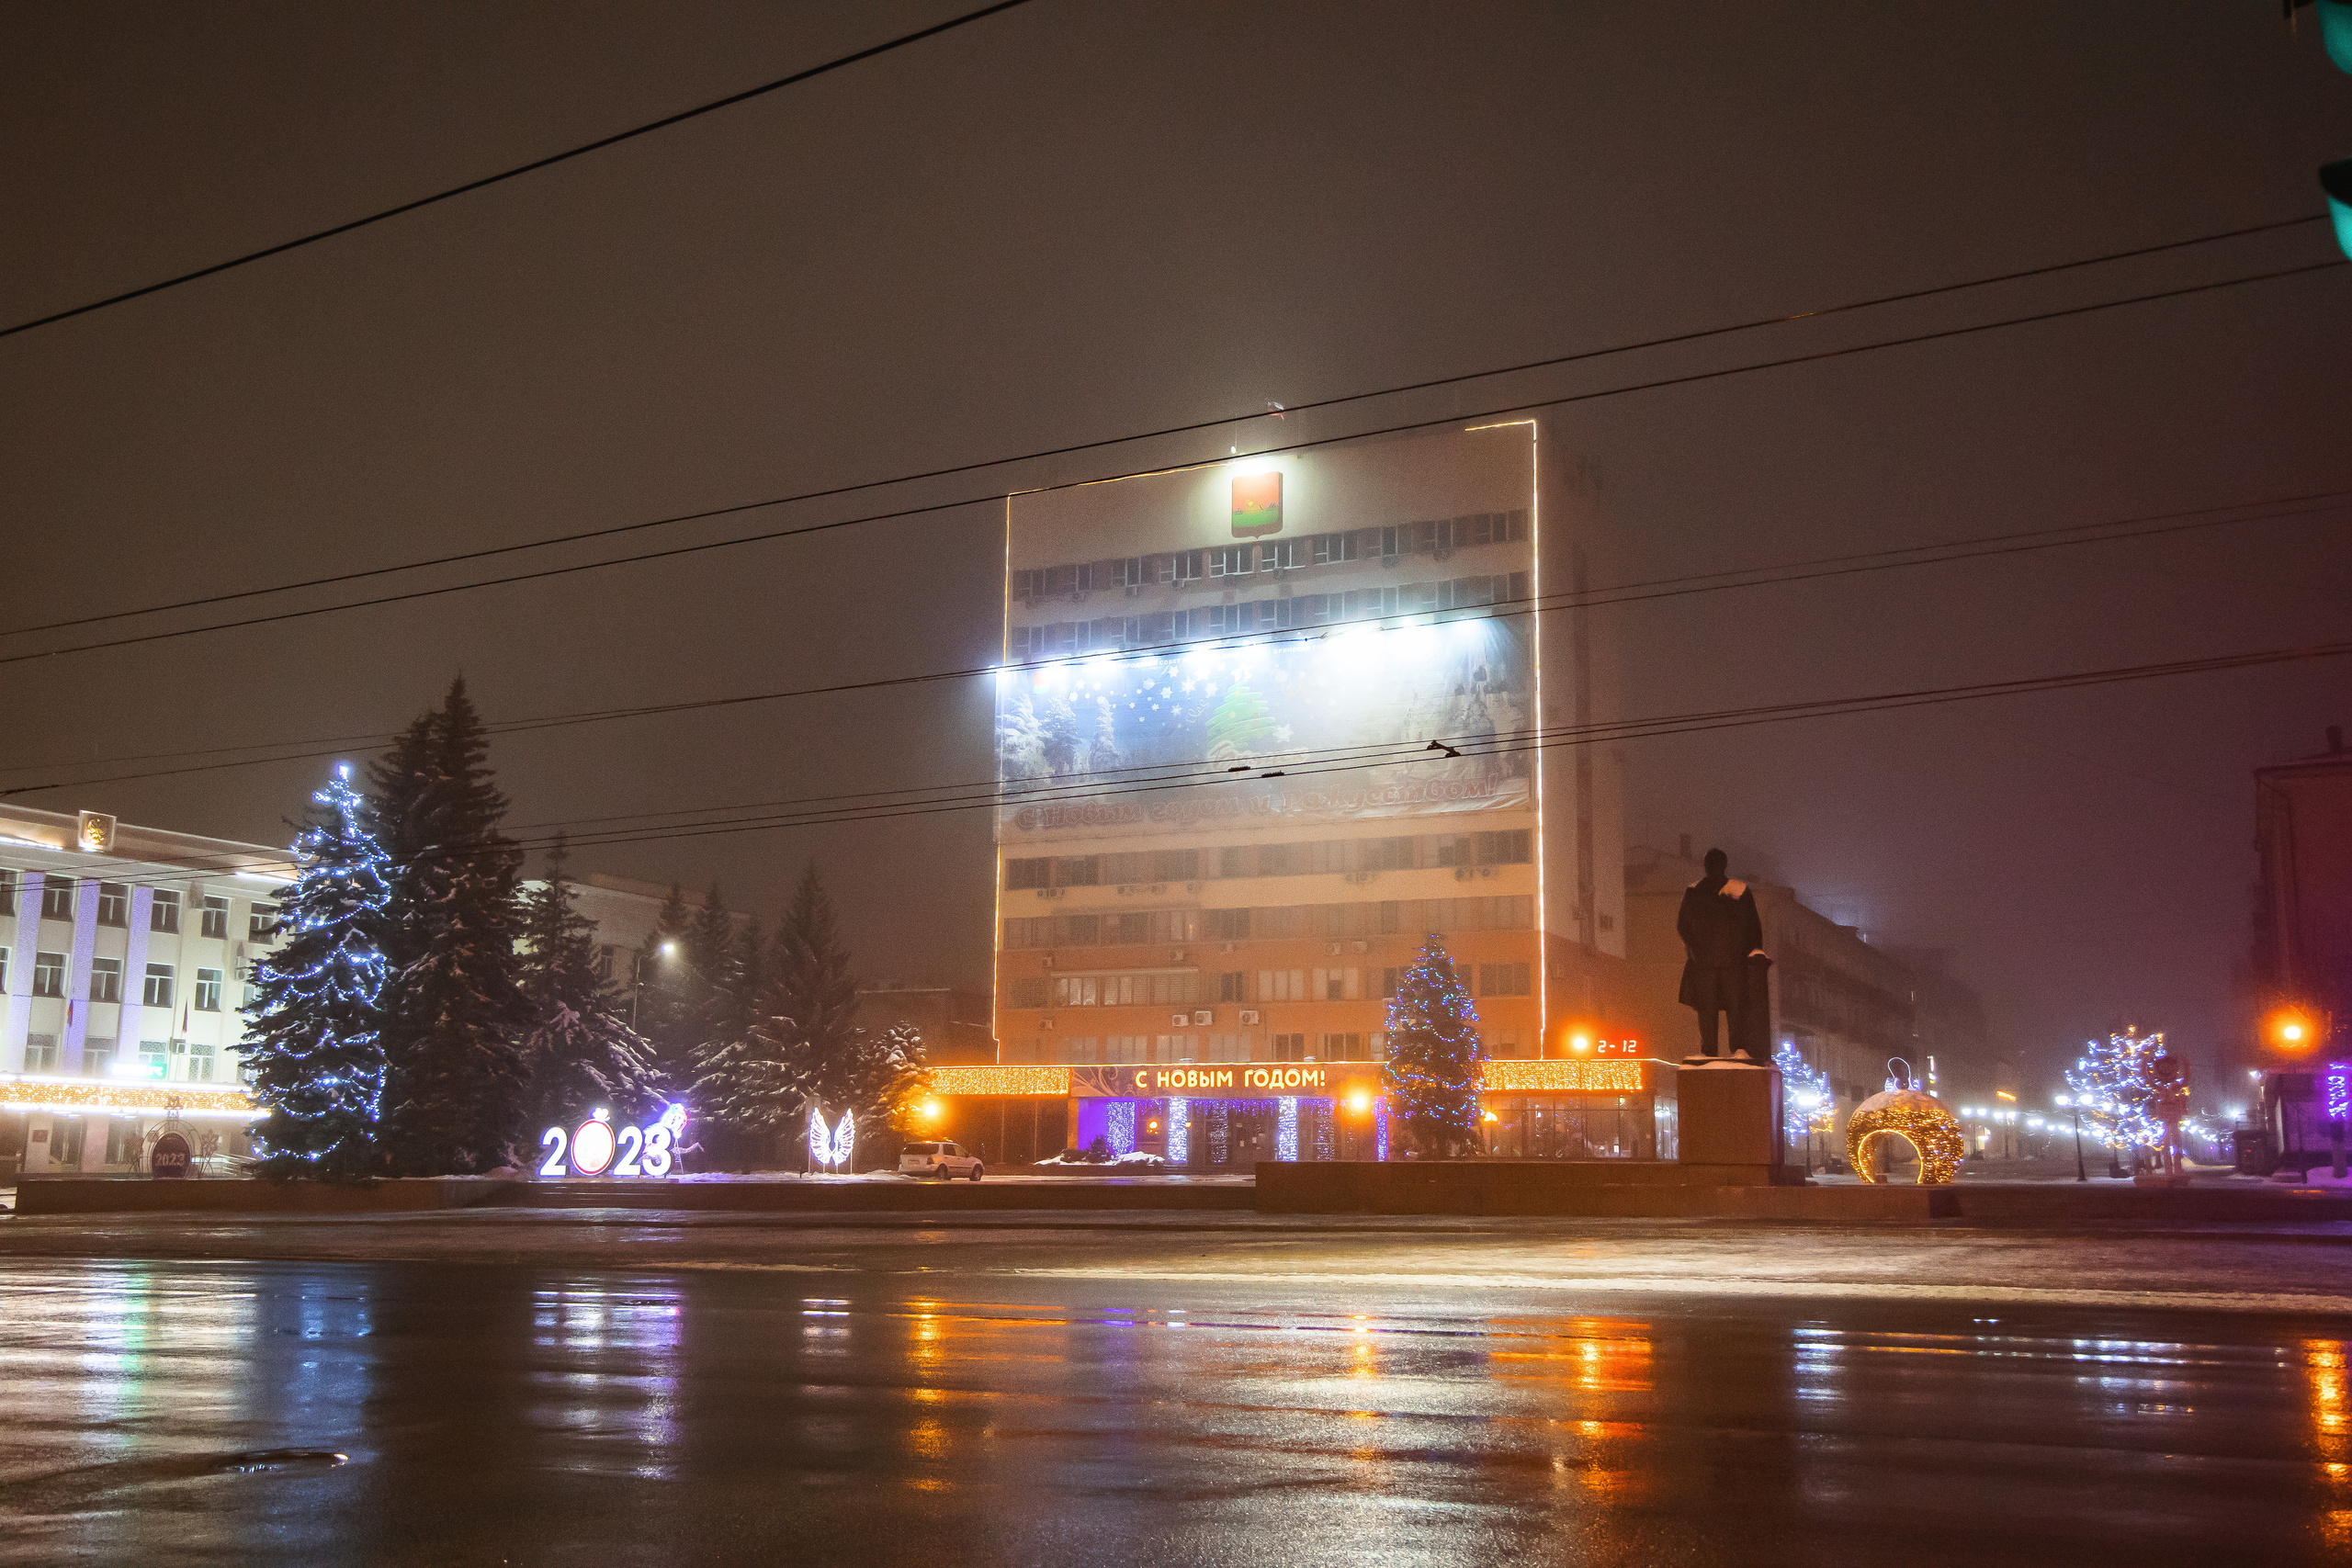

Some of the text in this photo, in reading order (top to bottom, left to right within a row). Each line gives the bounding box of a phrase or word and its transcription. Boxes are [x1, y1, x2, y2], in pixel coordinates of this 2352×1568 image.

[1017, 807, 1036, 828] С
[1044, 801, 1143, 828] Новым
[1135, 1069, 1326, 1089] С НОВЫМ ГОДОМ!
[539, 1119, 672, 1177] 2023
[155, 1153, 186, 1167] 2023
